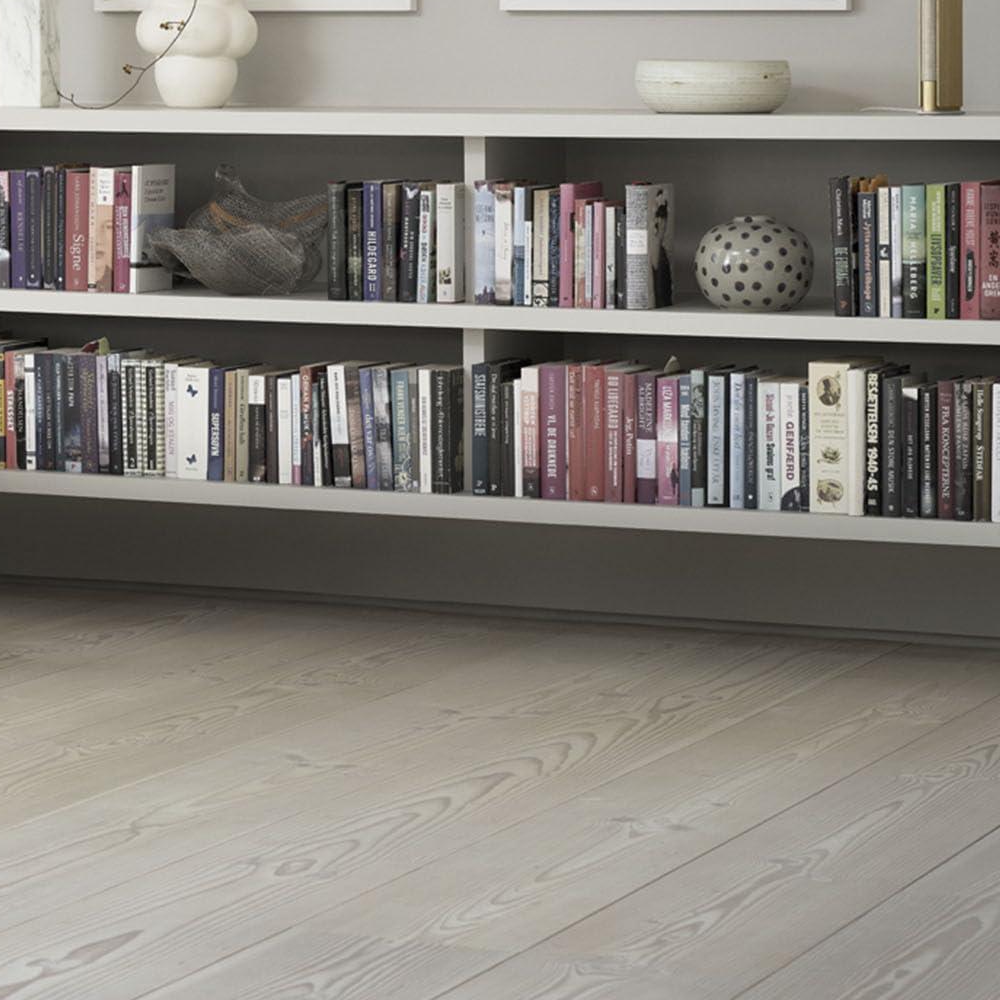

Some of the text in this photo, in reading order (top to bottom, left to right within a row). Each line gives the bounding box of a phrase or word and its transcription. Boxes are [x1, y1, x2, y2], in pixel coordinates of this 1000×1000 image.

[69, 233, 84, 272] Signe
[367, 231, 377, 281] HILDEGARD
[863, 221, 873, 300] Jytte vender tilbage
[909, 241, 918, 300] HELLEBERG
[930, 234, 942, 285] LIVSOPGAVER
[607, 375, 619, 388] BO
[661, 385, 674, 401] LIZA
[976, 389, 984, 407] Helle
[7, 389, 15, 432] STRESSET
[302, 404, 310, 431] PAMUK
[473, 373, 486, 437] STATSMINISTRENE
[607, 388, 619, 429] LIDEGAARD
[638, 384, 646, 431] ALBRIGHT
[644, 382, 653, 433] MADELEINE
[210, 412, 221, 457] SUPERSØVN
[546, 427, 557, 438] DE
[624, 433, 634, 456] Putin
[785, 421, 795, 481] GENFÆRD
[866, 373, 879, 491] BESÆTTELSEN 1940-45
[941, 405, 951, 499] FRA KONCEPTERNE
[546, 439, 557, 479] DRUKNEDE
[764, 467, 776, 481] graf
[887, 447, 895, 469] STORE
[887, 470, 895, 494] MUSIK
